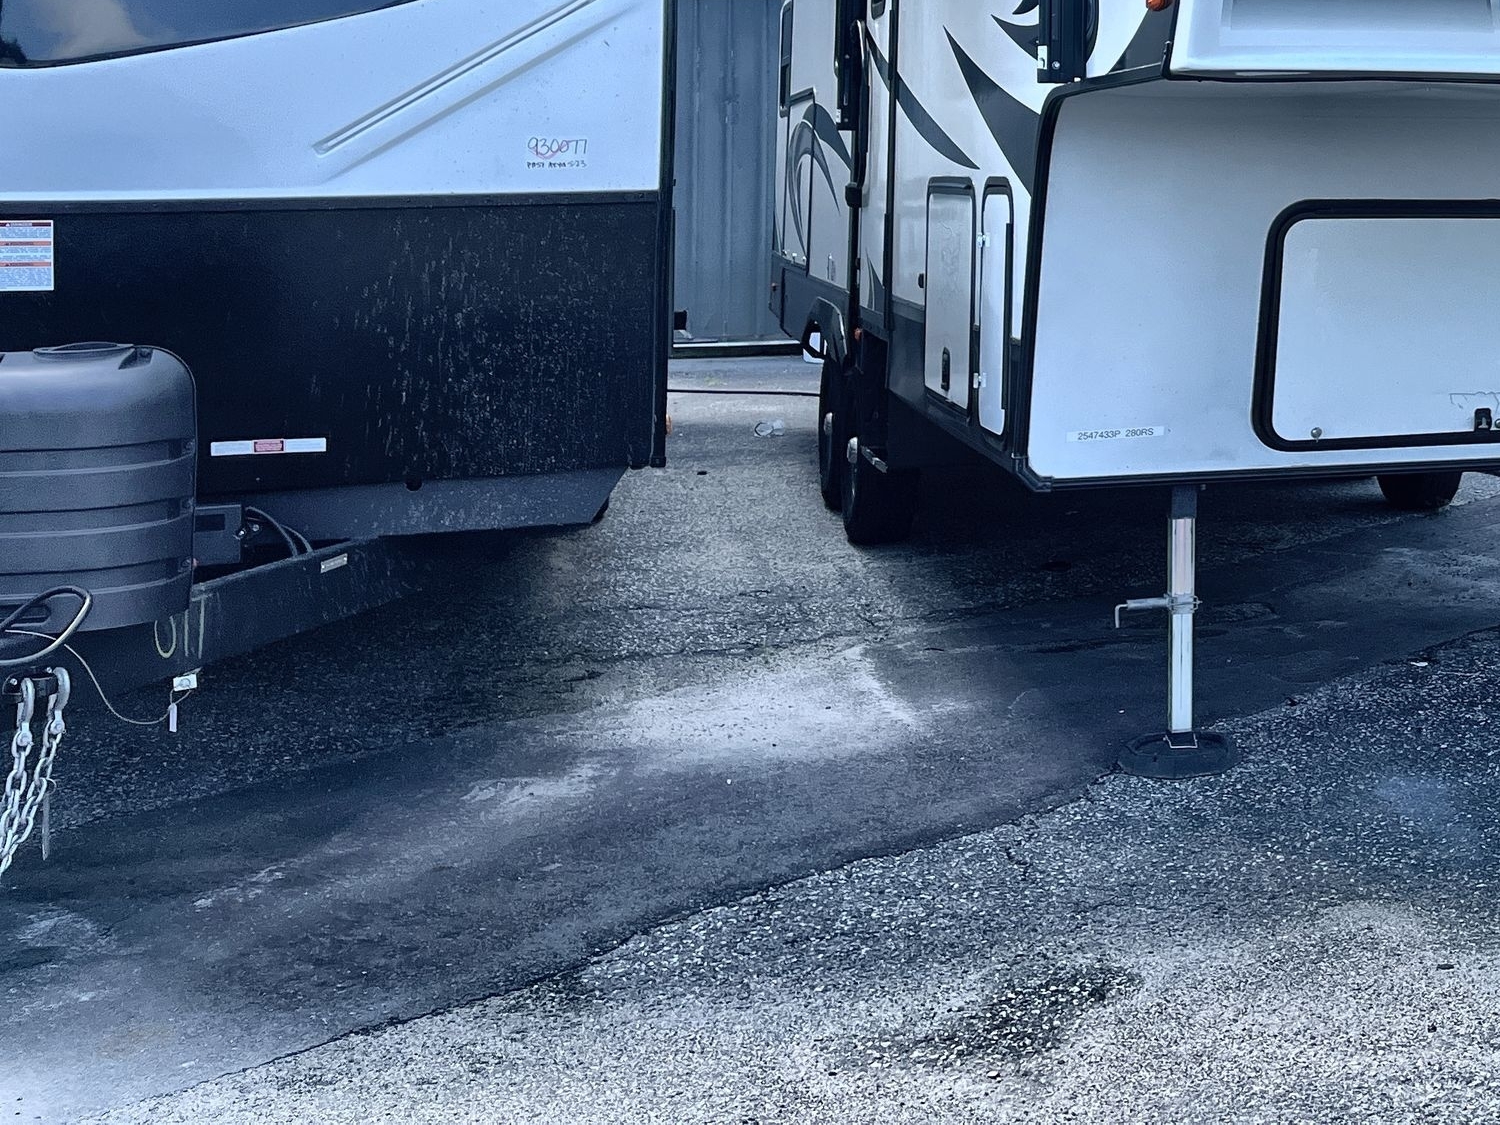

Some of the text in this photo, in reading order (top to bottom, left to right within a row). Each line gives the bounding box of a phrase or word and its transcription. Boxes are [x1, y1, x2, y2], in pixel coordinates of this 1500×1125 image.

[527, 136, 588, 156] 930077
[1077, 427, 1154, 441] 2547433P 280RS
